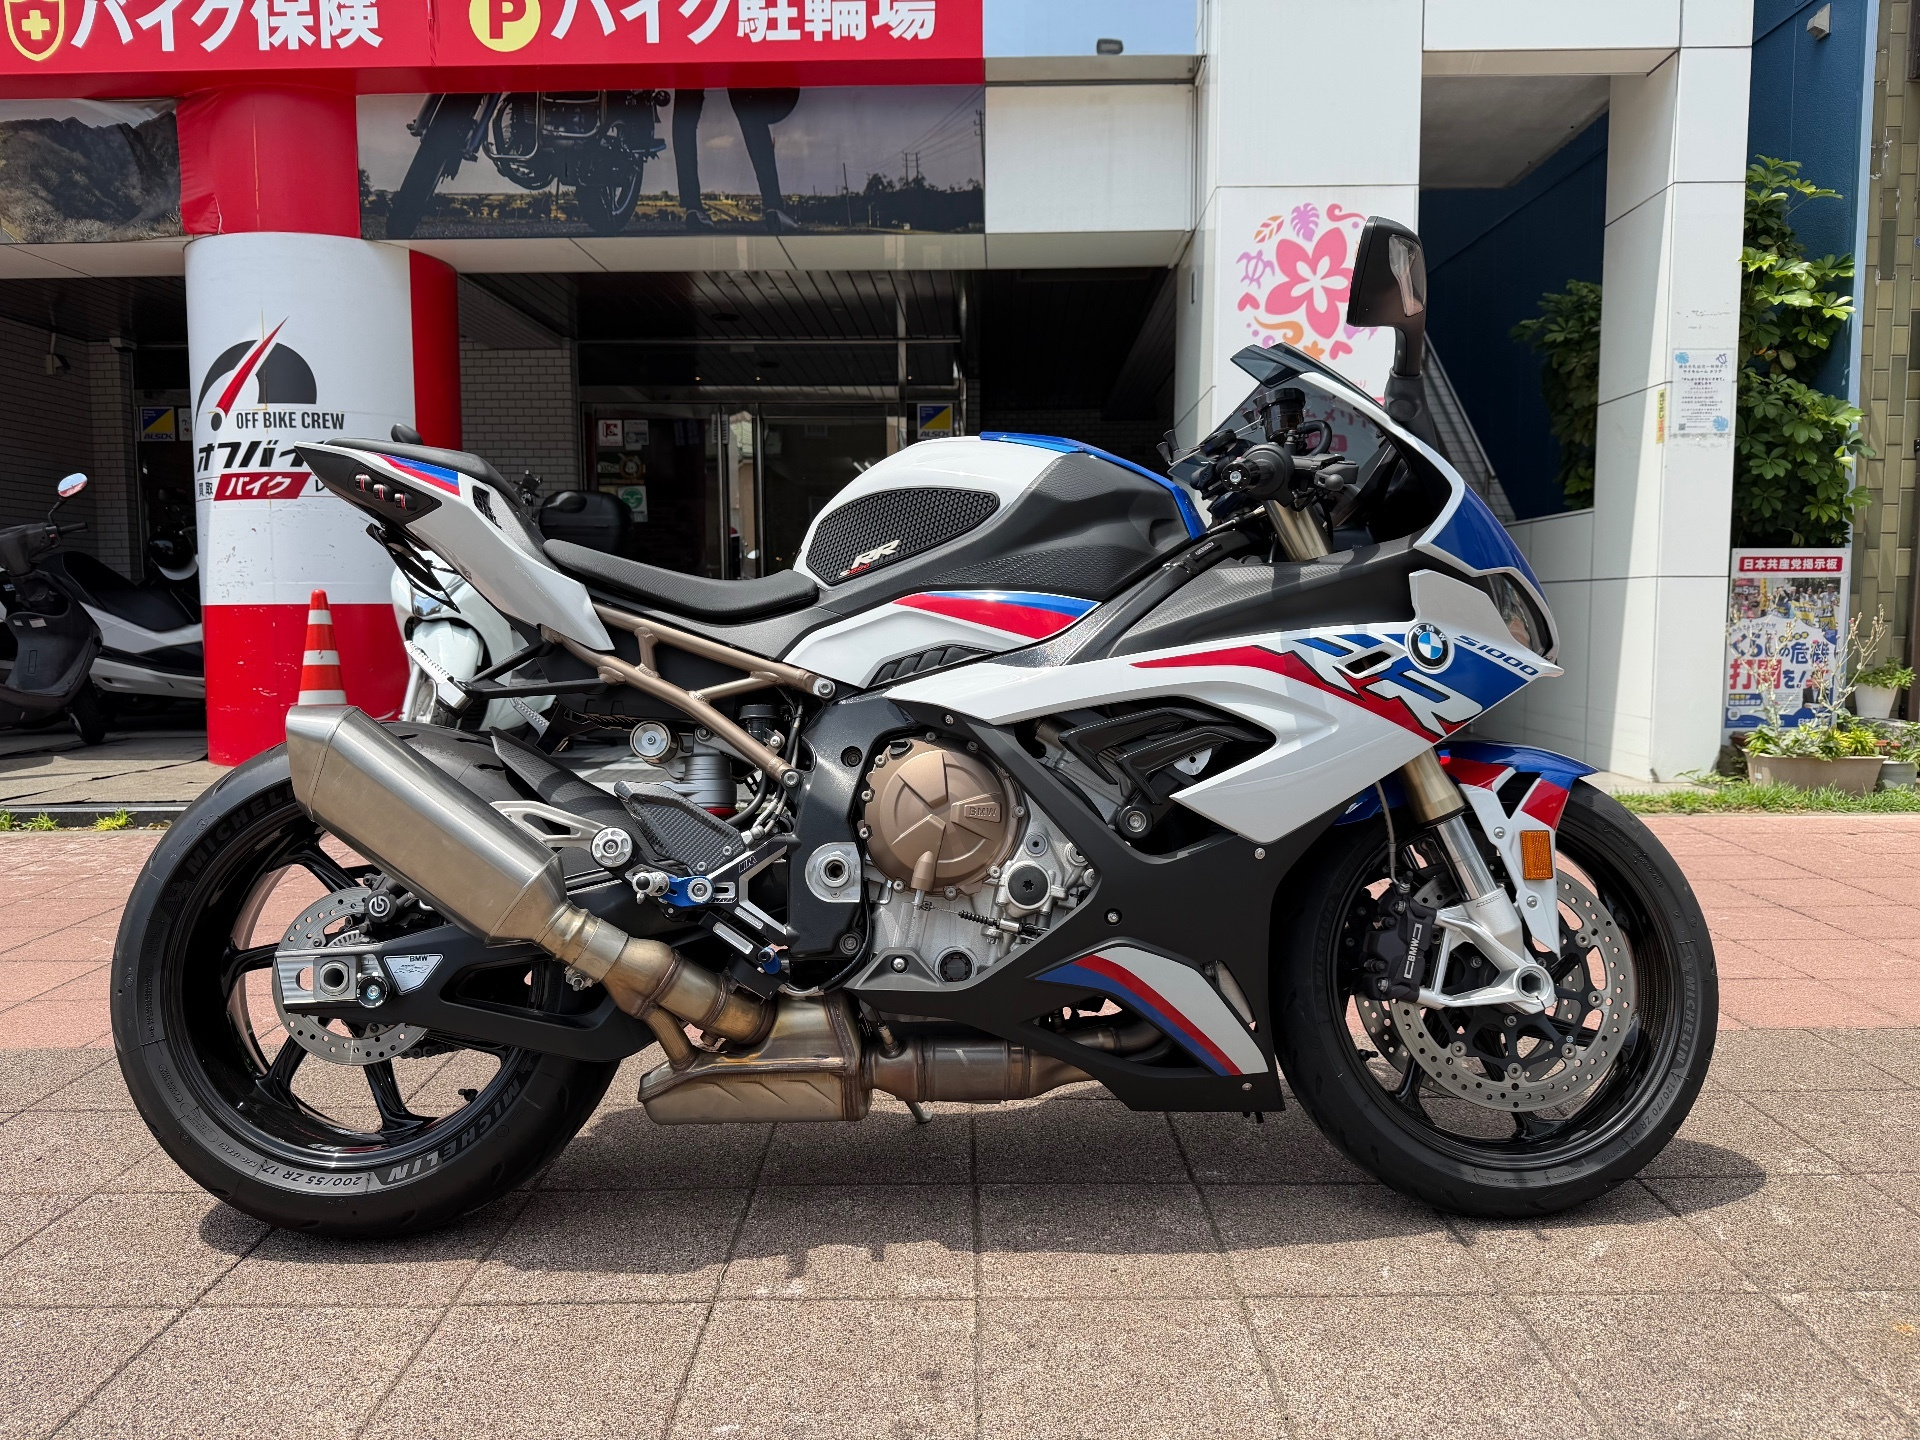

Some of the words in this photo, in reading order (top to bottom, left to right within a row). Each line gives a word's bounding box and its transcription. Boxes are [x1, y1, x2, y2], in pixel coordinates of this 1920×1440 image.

[70, 0, 384, 53] バイク保険
[551, 0, 937, 45] バイク駐輪場
[236, 411, 259, 430] OFF
[263, 411, 297, 429] BIKE
[301, 412, 345, 430] CREW
[197, 438, 326, 473] オフバイ
[224, 474, 293, 496] バイク
[850, 539, 901, 570] RR
[1743, 558, 1838, 571] 日本共産党掲示板
[1454, 634, 1540, 678] S1000
[969, 805, 998, 818] BMW
[409, 954, 429, 963] BMW
[1407, 937, 1420, 962] BMW
[1676, 974, 1697, 1066] MICHELIN
[1651, 1080, 1677, 1117] 120/70
[386, 1077, 522, 1183] MICHELIN
[262, 1164, 281, 1175] 17
[282, 1169, 304, 1182] ZR
[308, 1174, 363, 1187] 200/55
